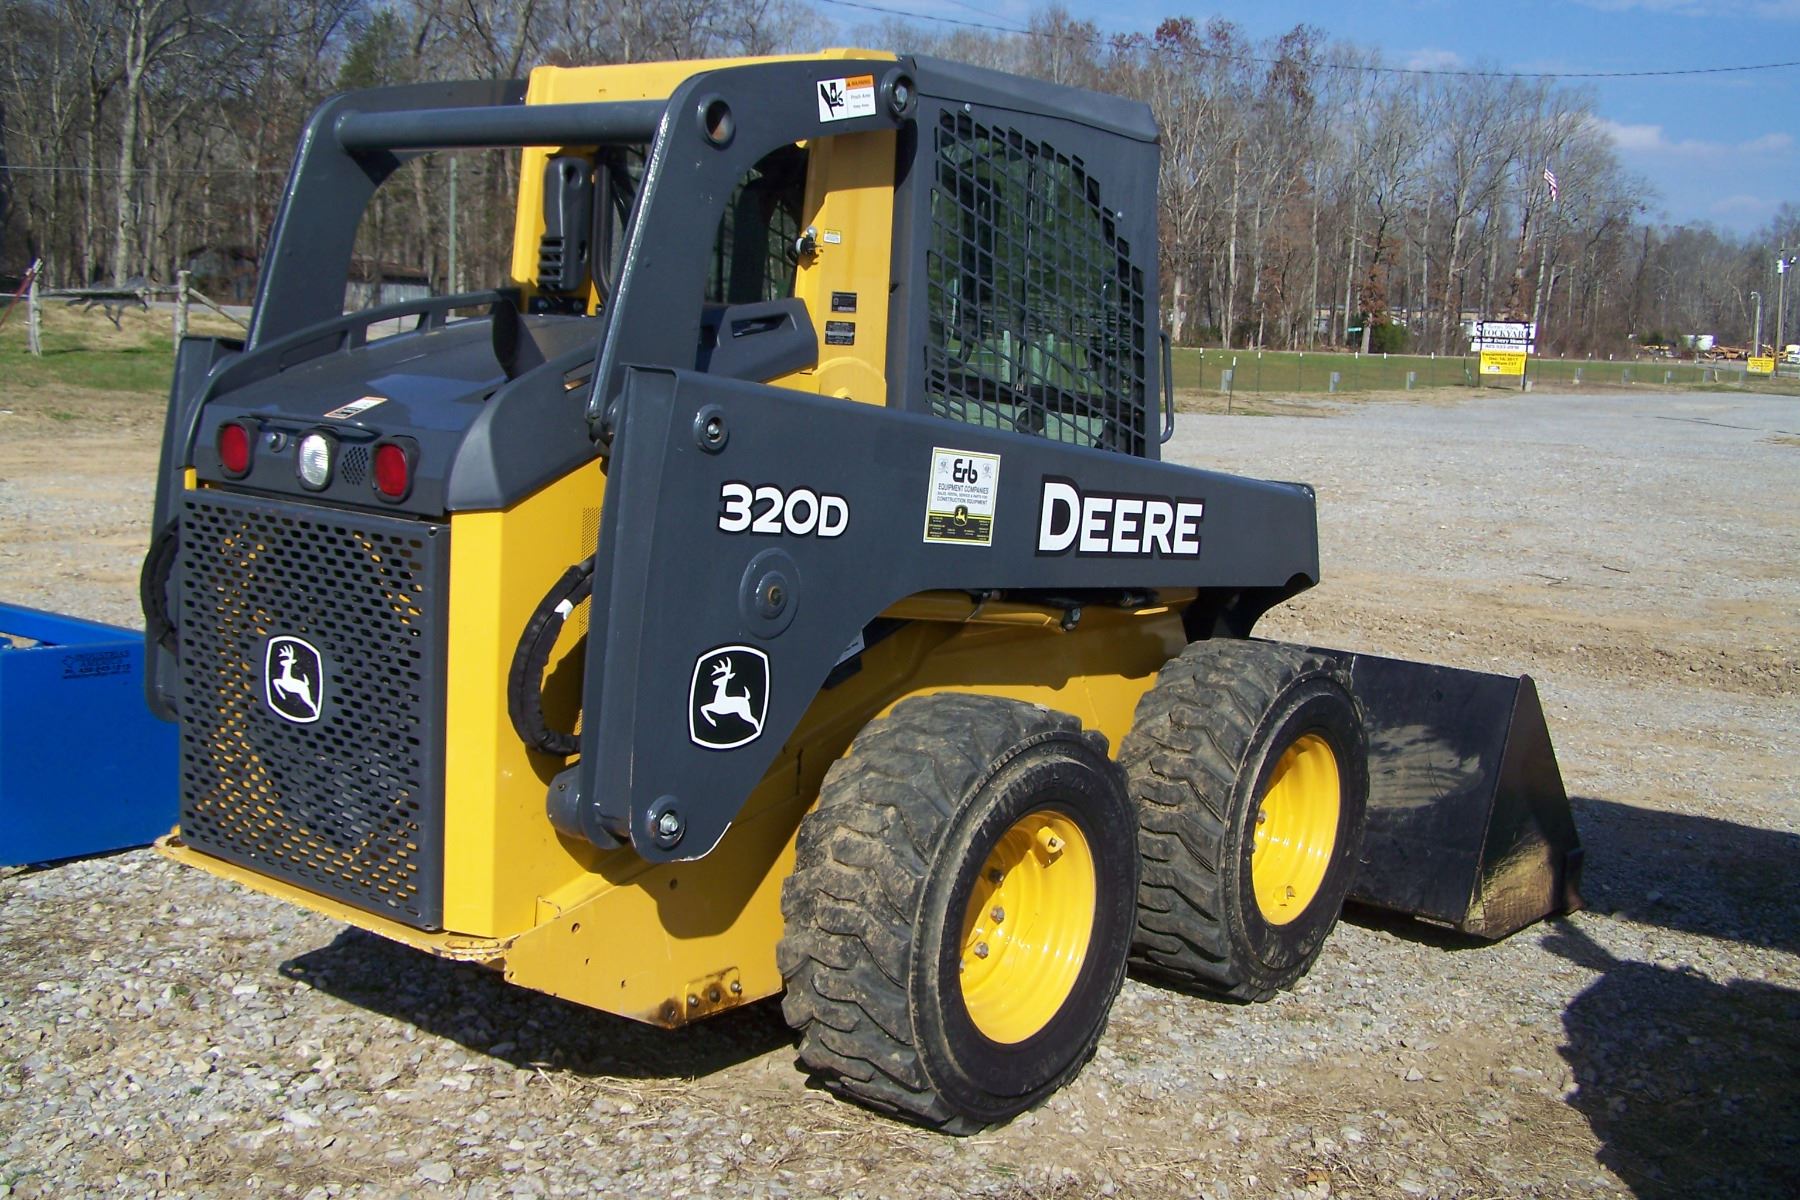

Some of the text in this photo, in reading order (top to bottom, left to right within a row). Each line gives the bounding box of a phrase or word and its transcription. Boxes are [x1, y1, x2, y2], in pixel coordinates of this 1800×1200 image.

[938, 482, 989, 494] EQUIPMENT COMPANIES
[719, 483, 849, 537] 320D
